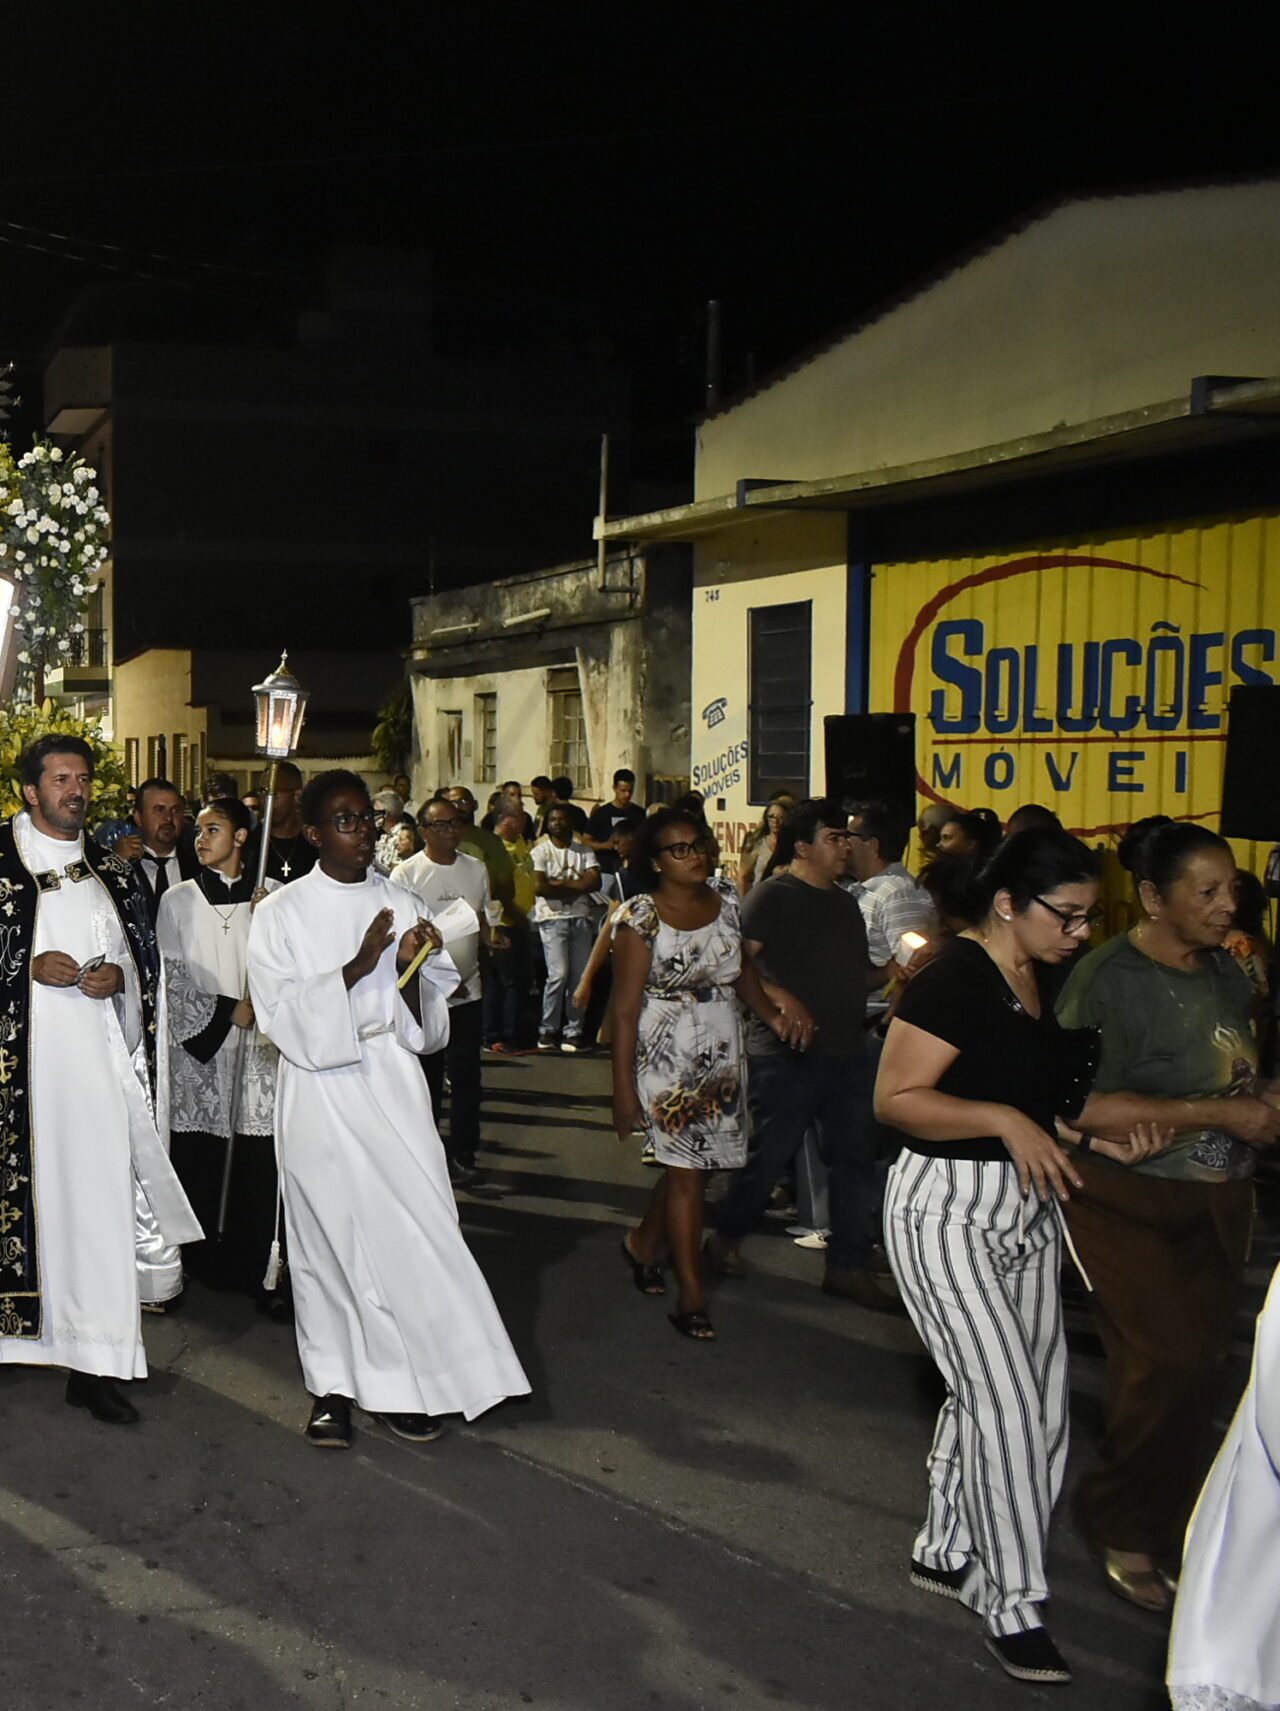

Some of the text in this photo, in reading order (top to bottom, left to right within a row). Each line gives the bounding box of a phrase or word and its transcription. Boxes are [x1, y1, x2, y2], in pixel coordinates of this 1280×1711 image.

[931, 619, 1276, 738] SOLUÇÕES
[693, 741, 749, 787] SOLUÇÕES
[932, 746, 1187, 793] MÓVEI
